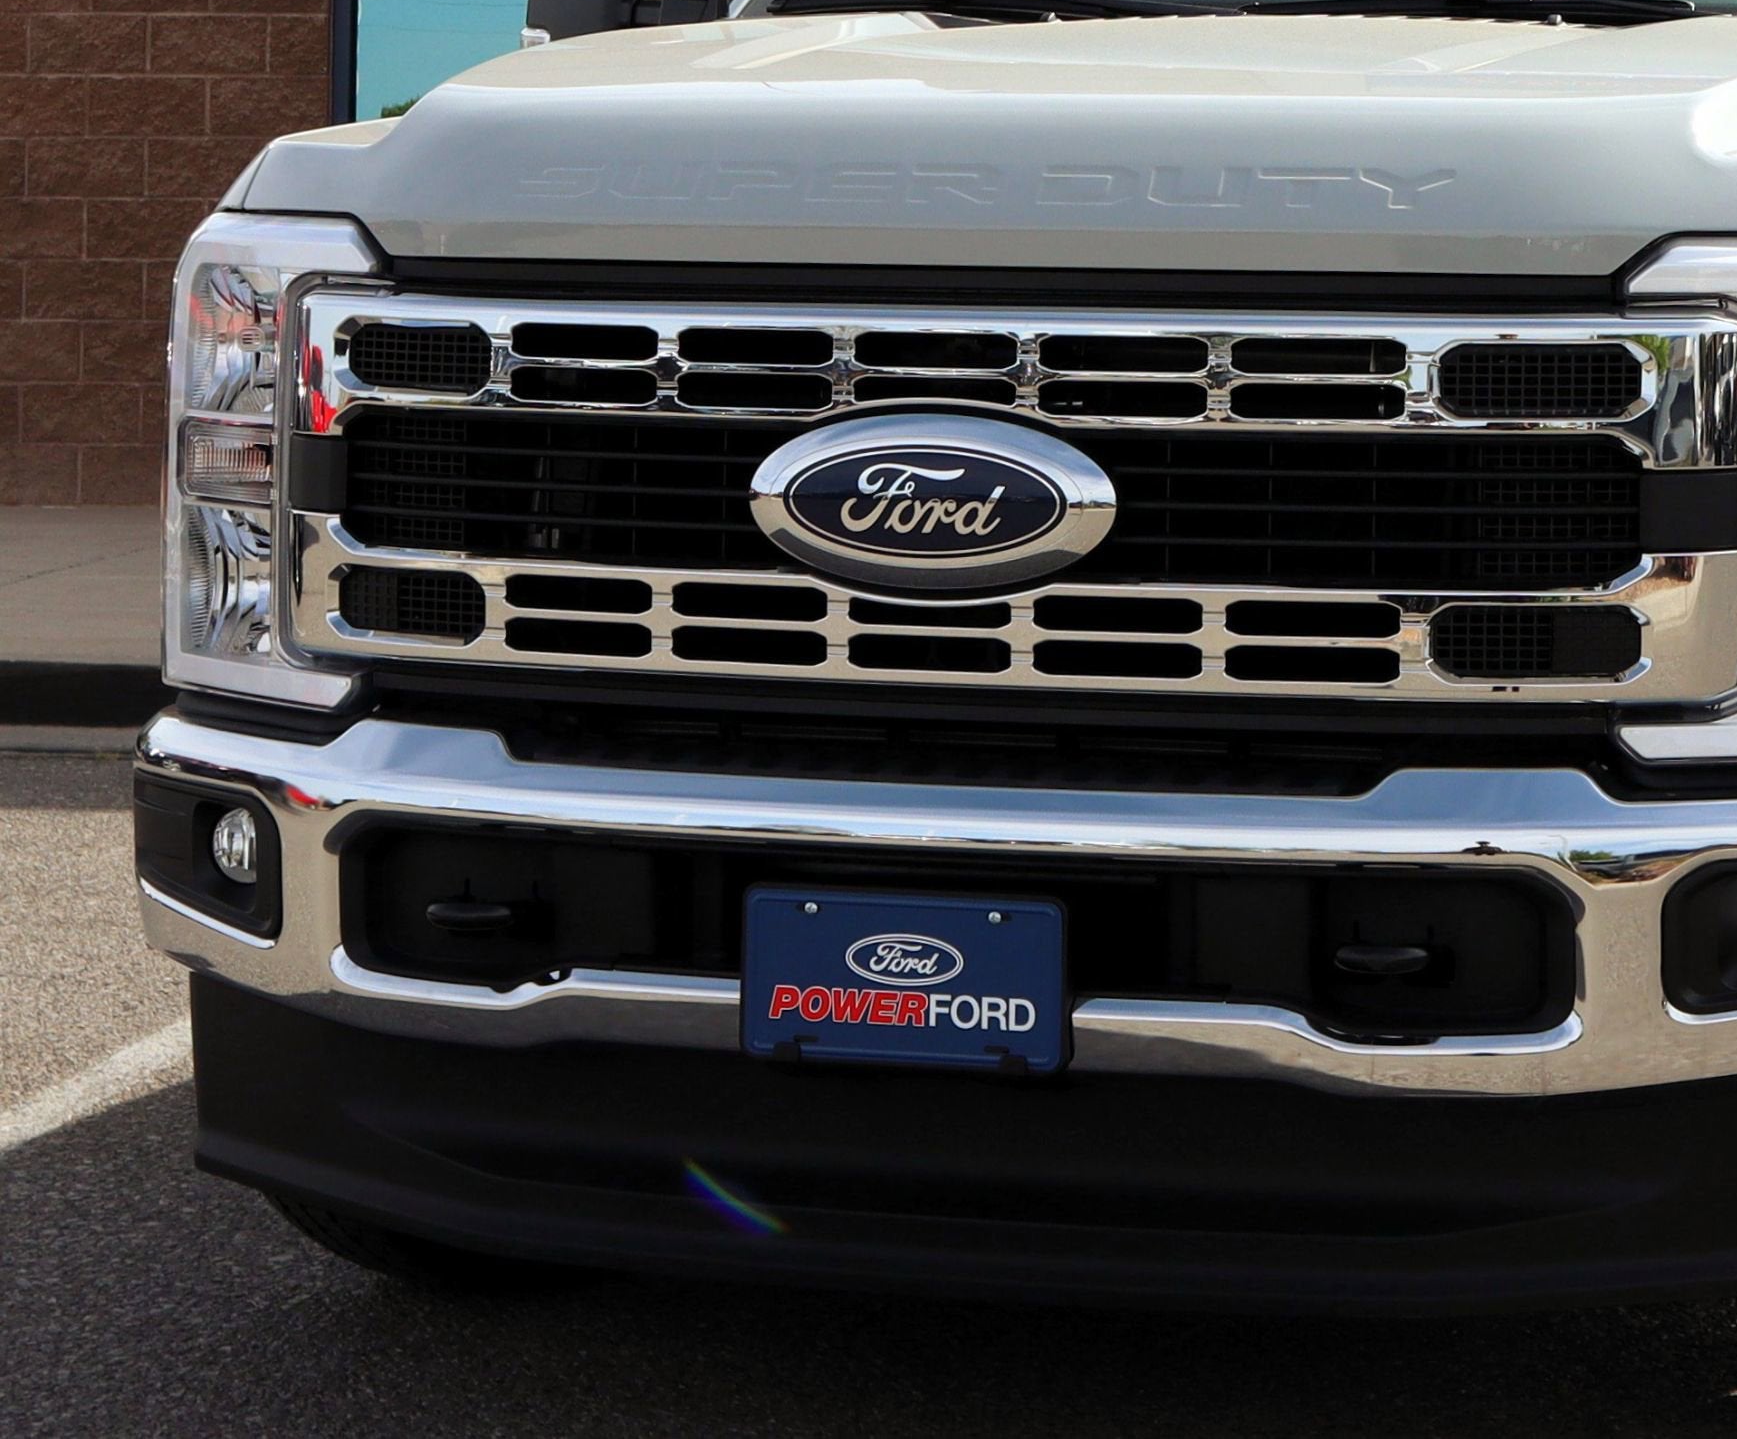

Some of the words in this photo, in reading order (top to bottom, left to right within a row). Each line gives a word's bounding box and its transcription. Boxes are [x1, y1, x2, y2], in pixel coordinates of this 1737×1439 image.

[516, 163, 998, 205] SUPER
[1035, 165, 1458, 210] DUTY
[840, 462, 1006, 536] Ford
[869, 942, 940, 976] Ford
[768, 984, 1036, 1033] POWERFORD
